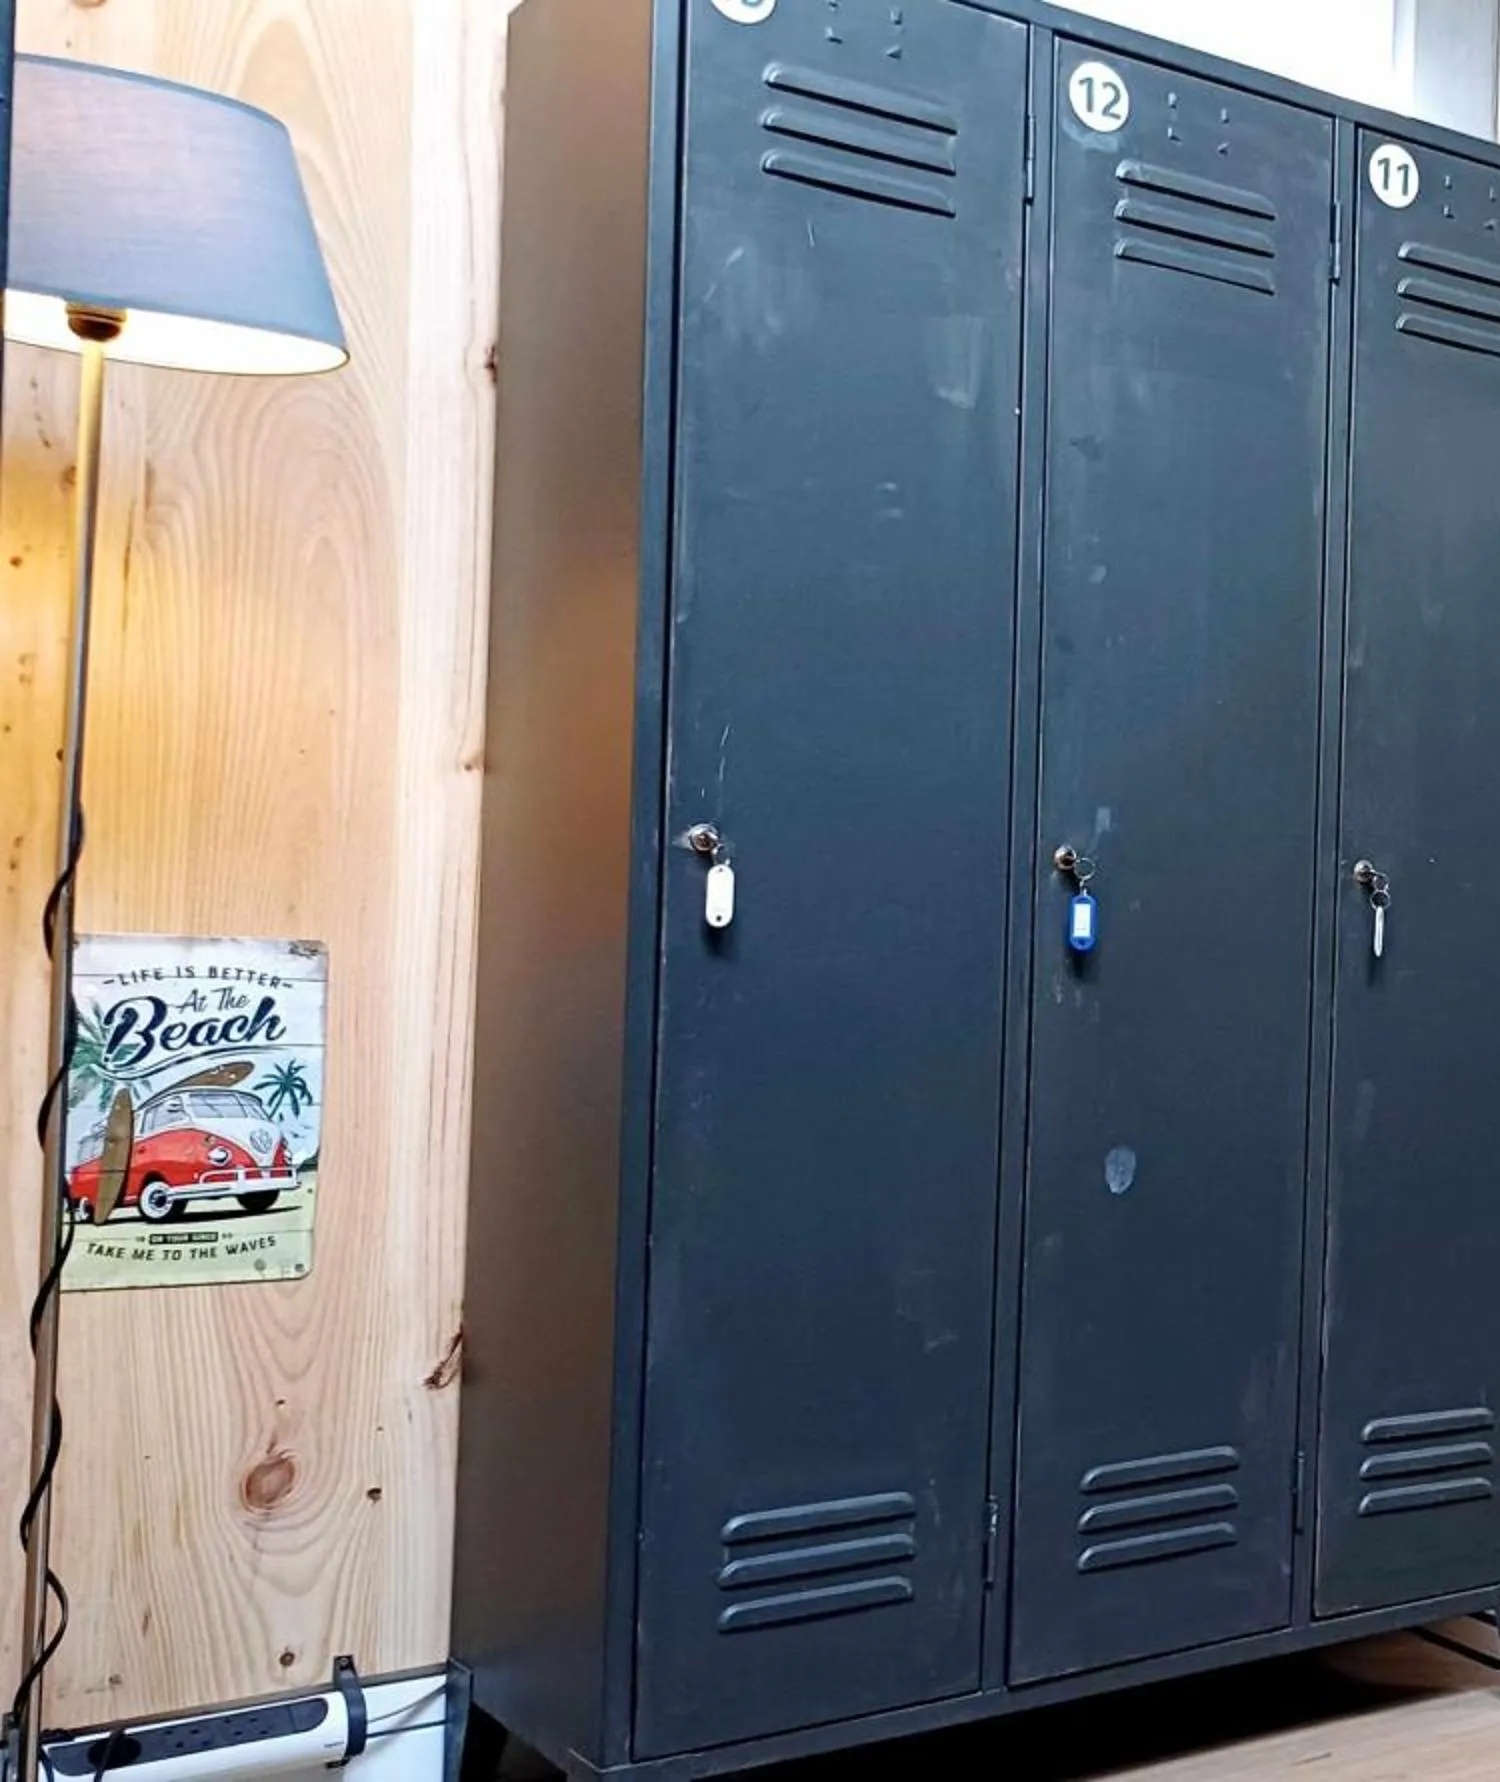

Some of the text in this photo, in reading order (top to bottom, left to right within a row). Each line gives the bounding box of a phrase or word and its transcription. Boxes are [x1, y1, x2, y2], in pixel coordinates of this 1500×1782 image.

[1078, 76, 1122, 120] 12
[1377, 157, 1409, 197] 11
[117, 966, 283, 989] LIFE IS BETTER
[174, 985, 248, 1014] At The
[103, 995, 286, 1069] Beach
[86, 1242, 124, 1259] TAKE
[131, 1248, 155, 1261] ME
[162, 1249, 182, 1261] TO
[190, 1246, 217, 1259] THE
[225, 1234, 276, 1255] WAVES
